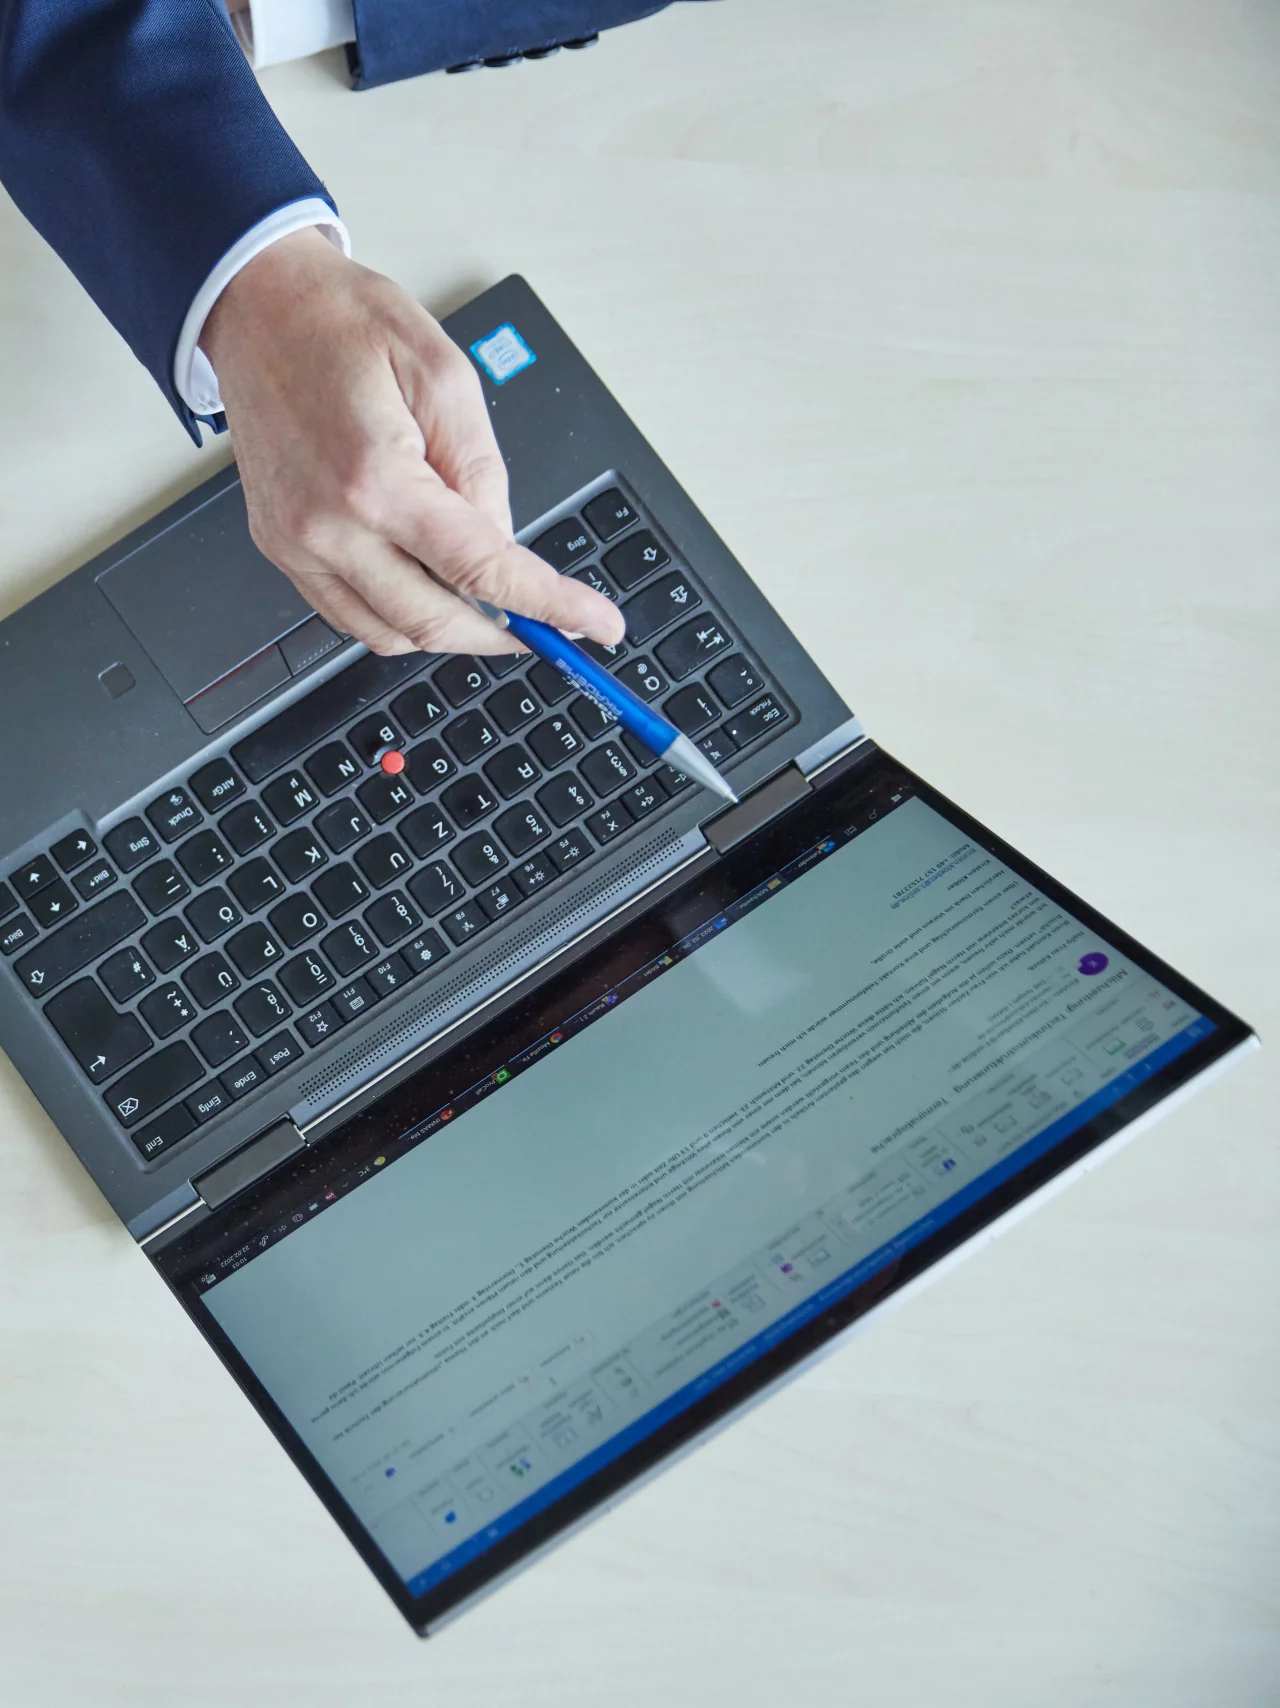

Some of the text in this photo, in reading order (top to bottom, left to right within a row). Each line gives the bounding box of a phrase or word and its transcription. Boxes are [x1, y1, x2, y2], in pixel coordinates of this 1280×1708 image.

[615, 506, 630, 519] Fn
[566, 535, 587, 551] Strg
[466, 672, 482, 688] C
[554, 657, 623, 714] AKADEMIE
[643, 675, 660, 691] Q
[426, 702, 441, 718] V
[519, 697, 536, 714] D
[696, 697, 706, 709] 1
[762, 707, 780, 722] Esc
[379, 725, 395, 742] B
[480, 727, 493, 744] F
[560, 732, 577, 750] E
[703, 739, 713, 749] F1
[337, 758, 355, 777] N
[431, 758, 448, 774] G
[610, 755, 622, 768] 3
[516, 761, 534, 779] R
[293, 788, 313, 808] M
[389, 786, 407, 804] H
[567, 786, 577, 798] 4
[634, 786, 645, 796] F3
[477, 794, 491, 810] T
[167, 806, 194, 826] Druck
[525, 814, 537, 827] 5
[600, 810, 611, 820] F4
[350, 816, 360, 832] J
[432, 821, 449, 839] Z
[128, 836, 150, 852] Strg
[482, 844, 494, 857] 6
[558, 838, 570, 848] F5
[950, 843, 971, 859] Mobil:
[303, 845, 321, 864] K
[389, 852, 405, 869] U
[797, 847, 822, 868] Kalender
[523, 862, 535, 872] F6
[935, 858, 948, 869] +49
[924, 866, 937, 878] 157
[262, 875, 278, 889] L
[351, 880, 363, 894] I
[441, 874, 452, 887] 7
[1001, 880, 1019, 893] Über
[490, 886, 500, 897] F7
[982, 891, 1002, 907] einen
[218, 905, 234, 923] Ö
[395, 904, 408, 917] 8
[454, 910, 466, 921] F8
[869, 869, 1005, 964] Herzlichen Dank im Voraus und viele Grüße,
[302, 912, 318, 928] O
[930, 905, 985, 943] Terminvorschlag
[174, 934, 191, 953] Ä
[352, 932, 365, 946] 9
[413, 939, 424, 949] F9
[263, 940, 276, 957] P
[917, 941, 933, 954] und
[903, 951, 919, 963] eine
[309, 962, 322, 976] 0
[377, 962, 391, 974] F10
[643, 963, 660, 977] Bilder
[217, 971, 233, 988] Ü
[342, 986, 356, 999] F11
[308, 1010, 322, 1023] F12
[587, 1002, 606, 1016] Raum
[806, 1016, 829, 1033] würde
[795, 1030, 808, 1040] ich
[528, 1040, 551, 1057] Mozilla
[779, 1038, 797, 1052] mich
[269, 1047, 291, 1065] Pos1
[757, 1049, 781, 1067] freuen.
[233, 1070, 257, 1088] Ende
[474, 1078, 496, 1096] ProCall
[197, 1094, 222, 1113] Einfg
[419, 1117, 441, 1134] INMAS
[145, 1135, 164, 1152] Entf
[357, 1165, 371, 1177] 3°C
[219, 1244, 250, 1268] 22.02.2022
[231, 1256, 248, 1269] 10:03
